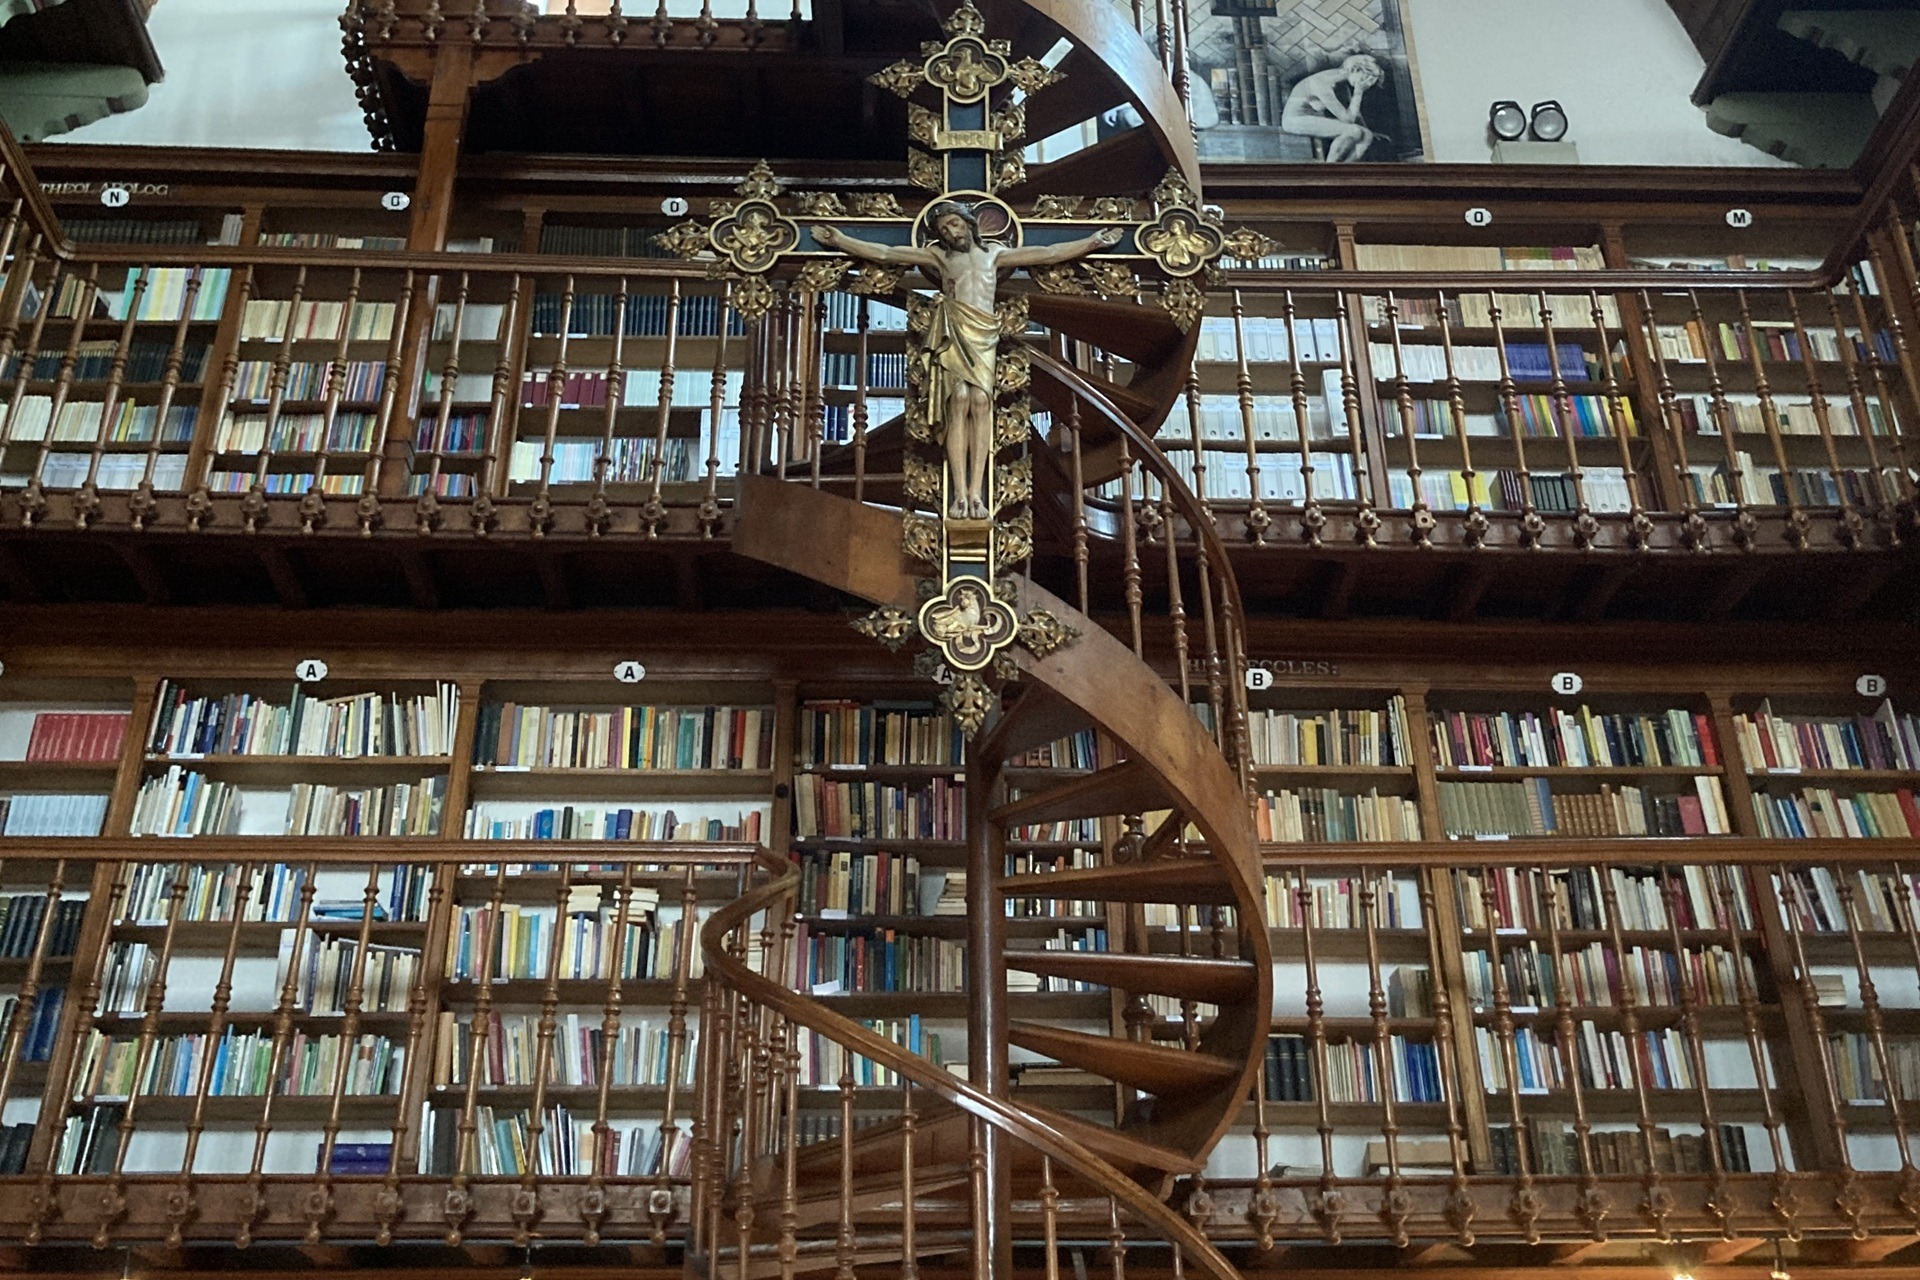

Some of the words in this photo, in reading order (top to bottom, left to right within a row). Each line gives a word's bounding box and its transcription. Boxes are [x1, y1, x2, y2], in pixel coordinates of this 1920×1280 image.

[109, 191, 120, 204] N
[1474, 211, 1485, 223] O
[1733, 212, 1747, 224] M
[305, 663, 317, 678] A
[623, 665, 635, 680] A
[941, 668, 953, 682] A
[1252, 672, 1264, 688] B
[1562, 676, 1574, 692] B
[1866, 678, 1879, 694] B
